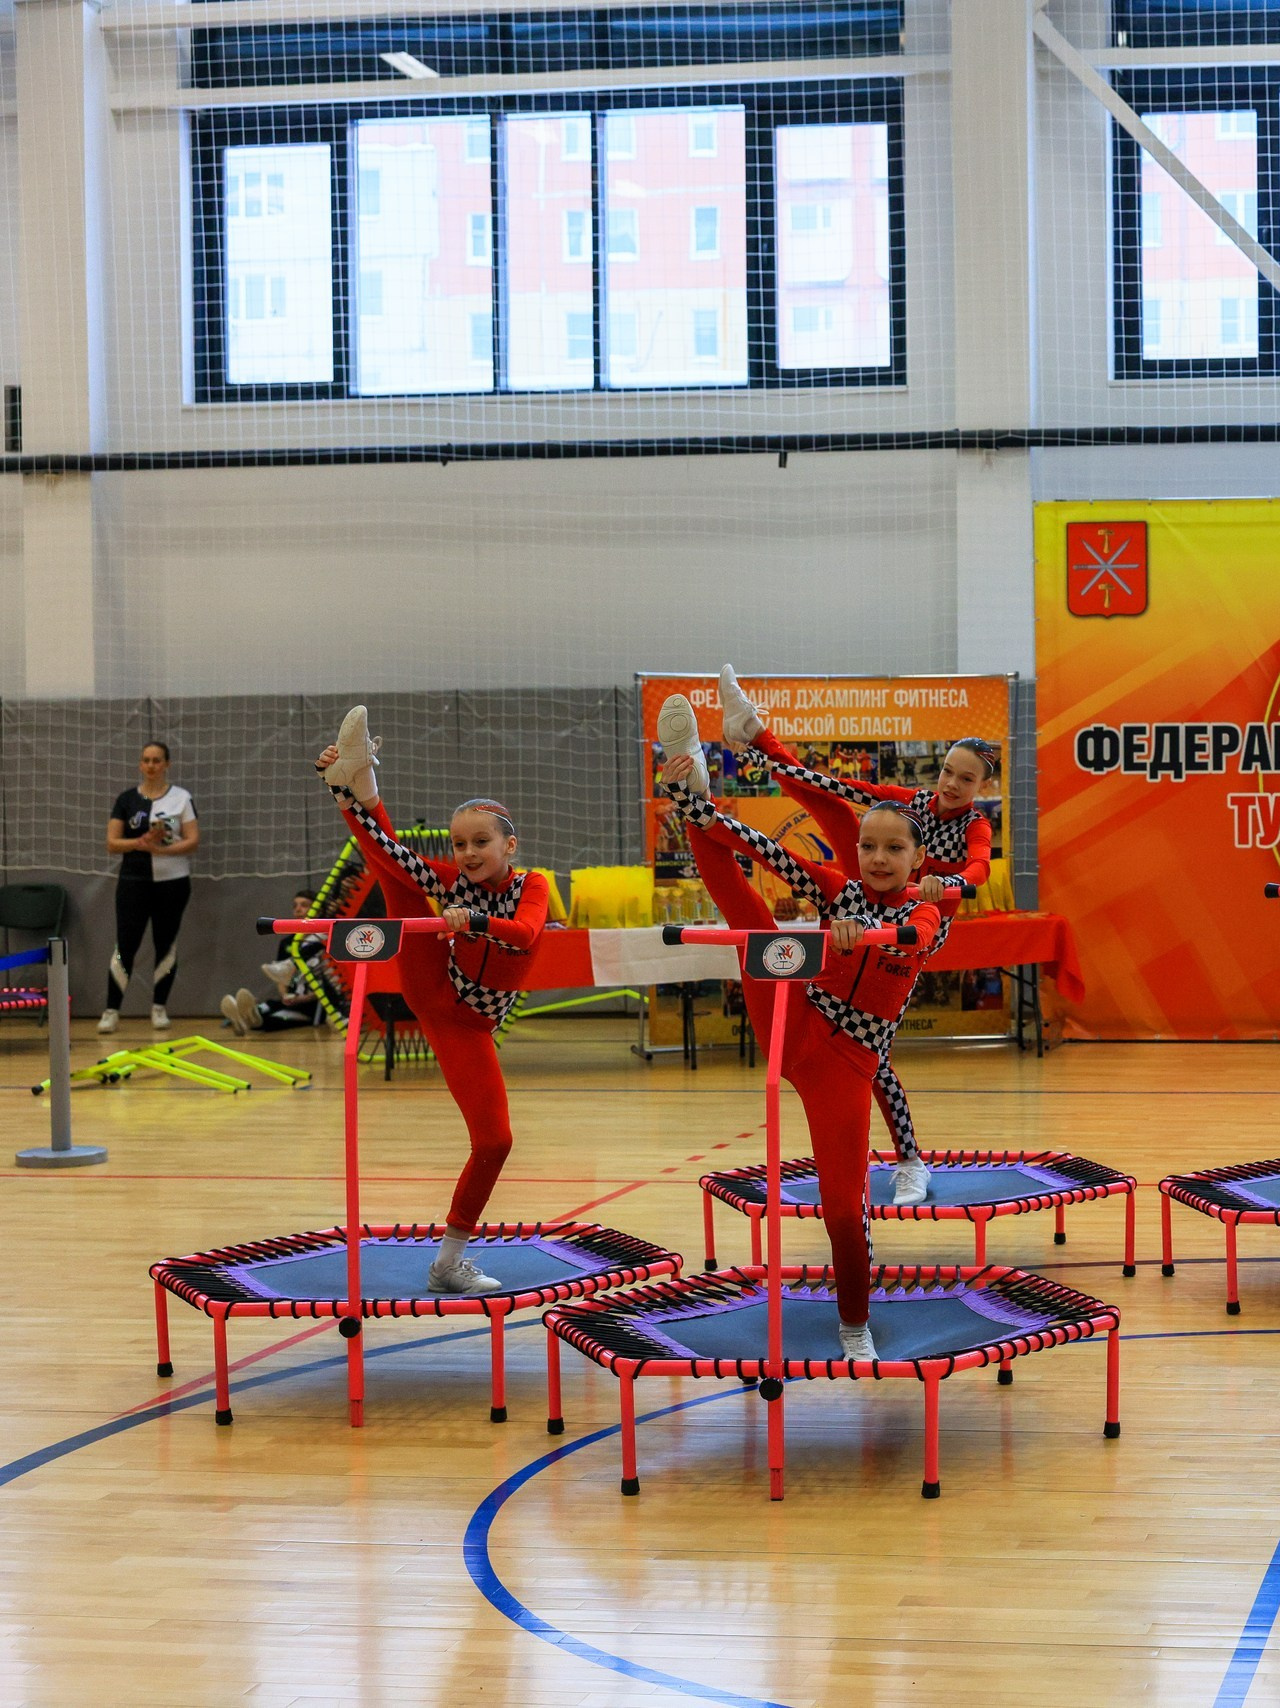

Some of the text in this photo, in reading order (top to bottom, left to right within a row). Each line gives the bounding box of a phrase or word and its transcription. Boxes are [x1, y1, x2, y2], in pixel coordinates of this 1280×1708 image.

[690, 688, 969, 710] ФЕАЦИЯ ДЖАМПИНГ ФИТНЕСА
[839, 716, 912, 737] ОБЛАСТИ
